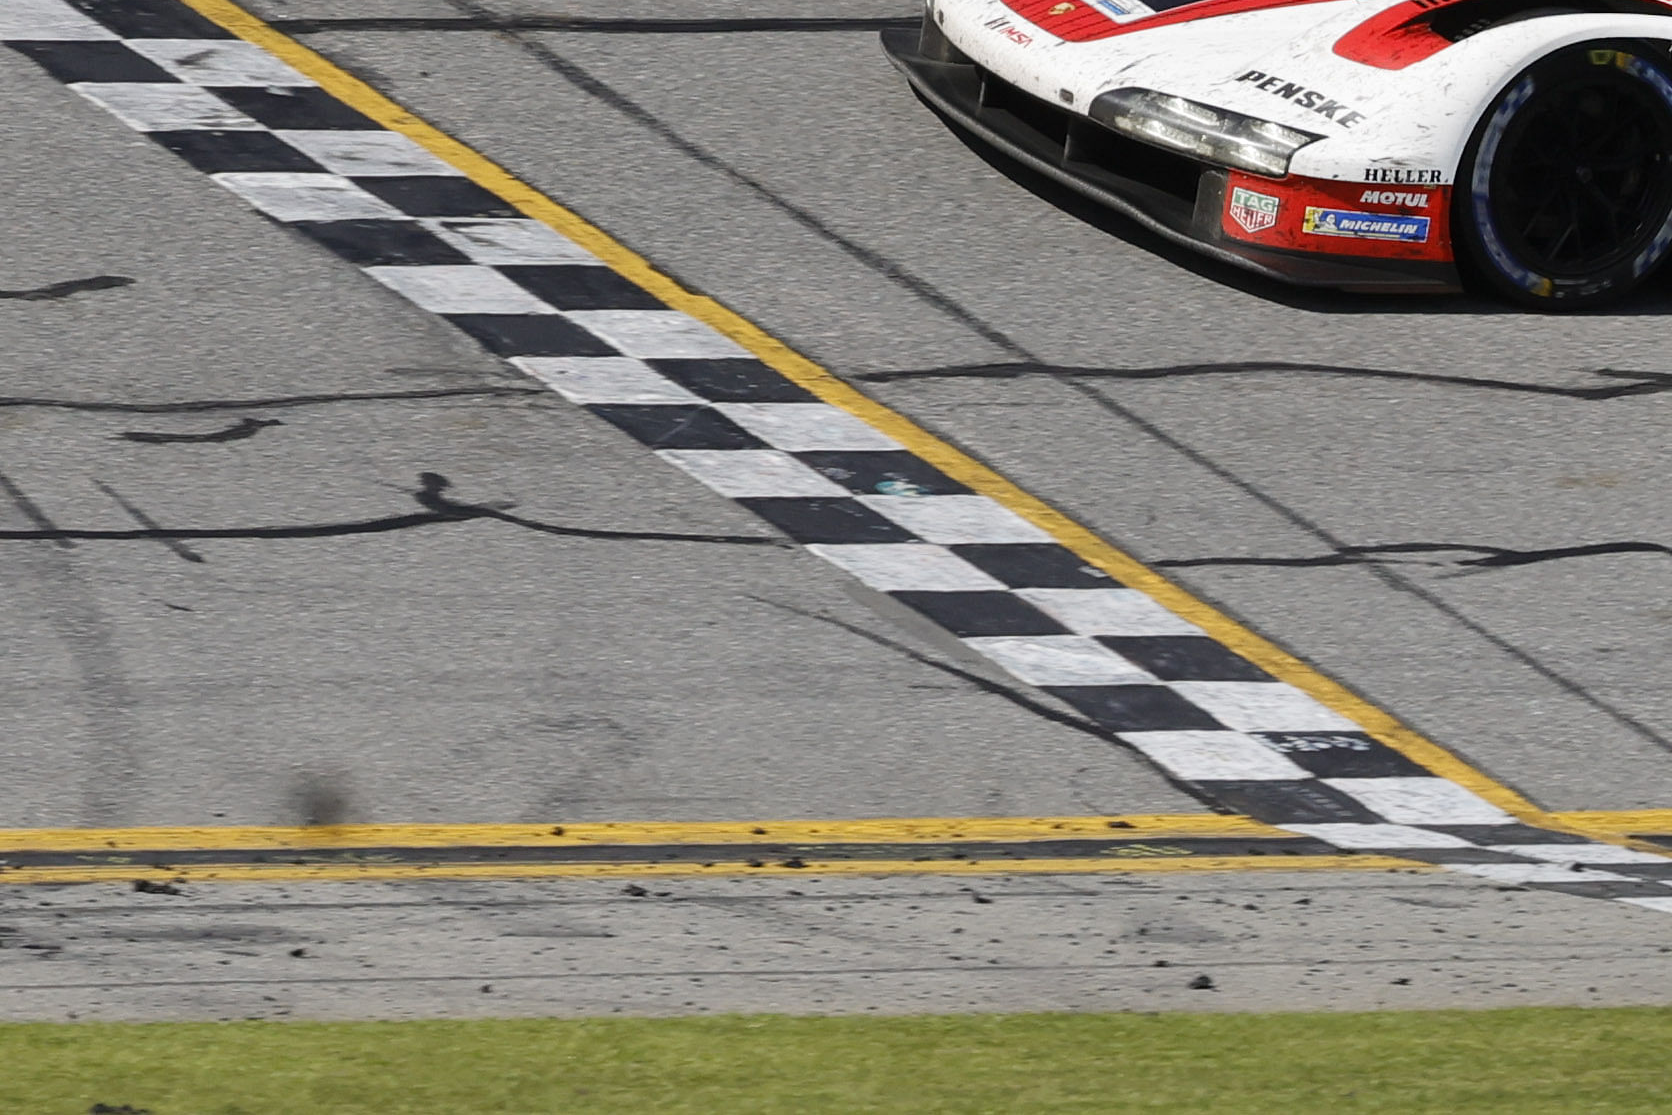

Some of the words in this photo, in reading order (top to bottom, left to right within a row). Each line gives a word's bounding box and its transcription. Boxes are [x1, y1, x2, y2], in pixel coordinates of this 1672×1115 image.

[1235, 69, 1367, 129] PENSKE
[1364, 168, 1442, 184] HELLER
[1237, 190, 1277, 213] TAG
[1359, 189, 1429, 208] MOTUL
[1231, 205, 1275, 230] HEUER
[1338, 219, 1419, 235] MICHELIN
